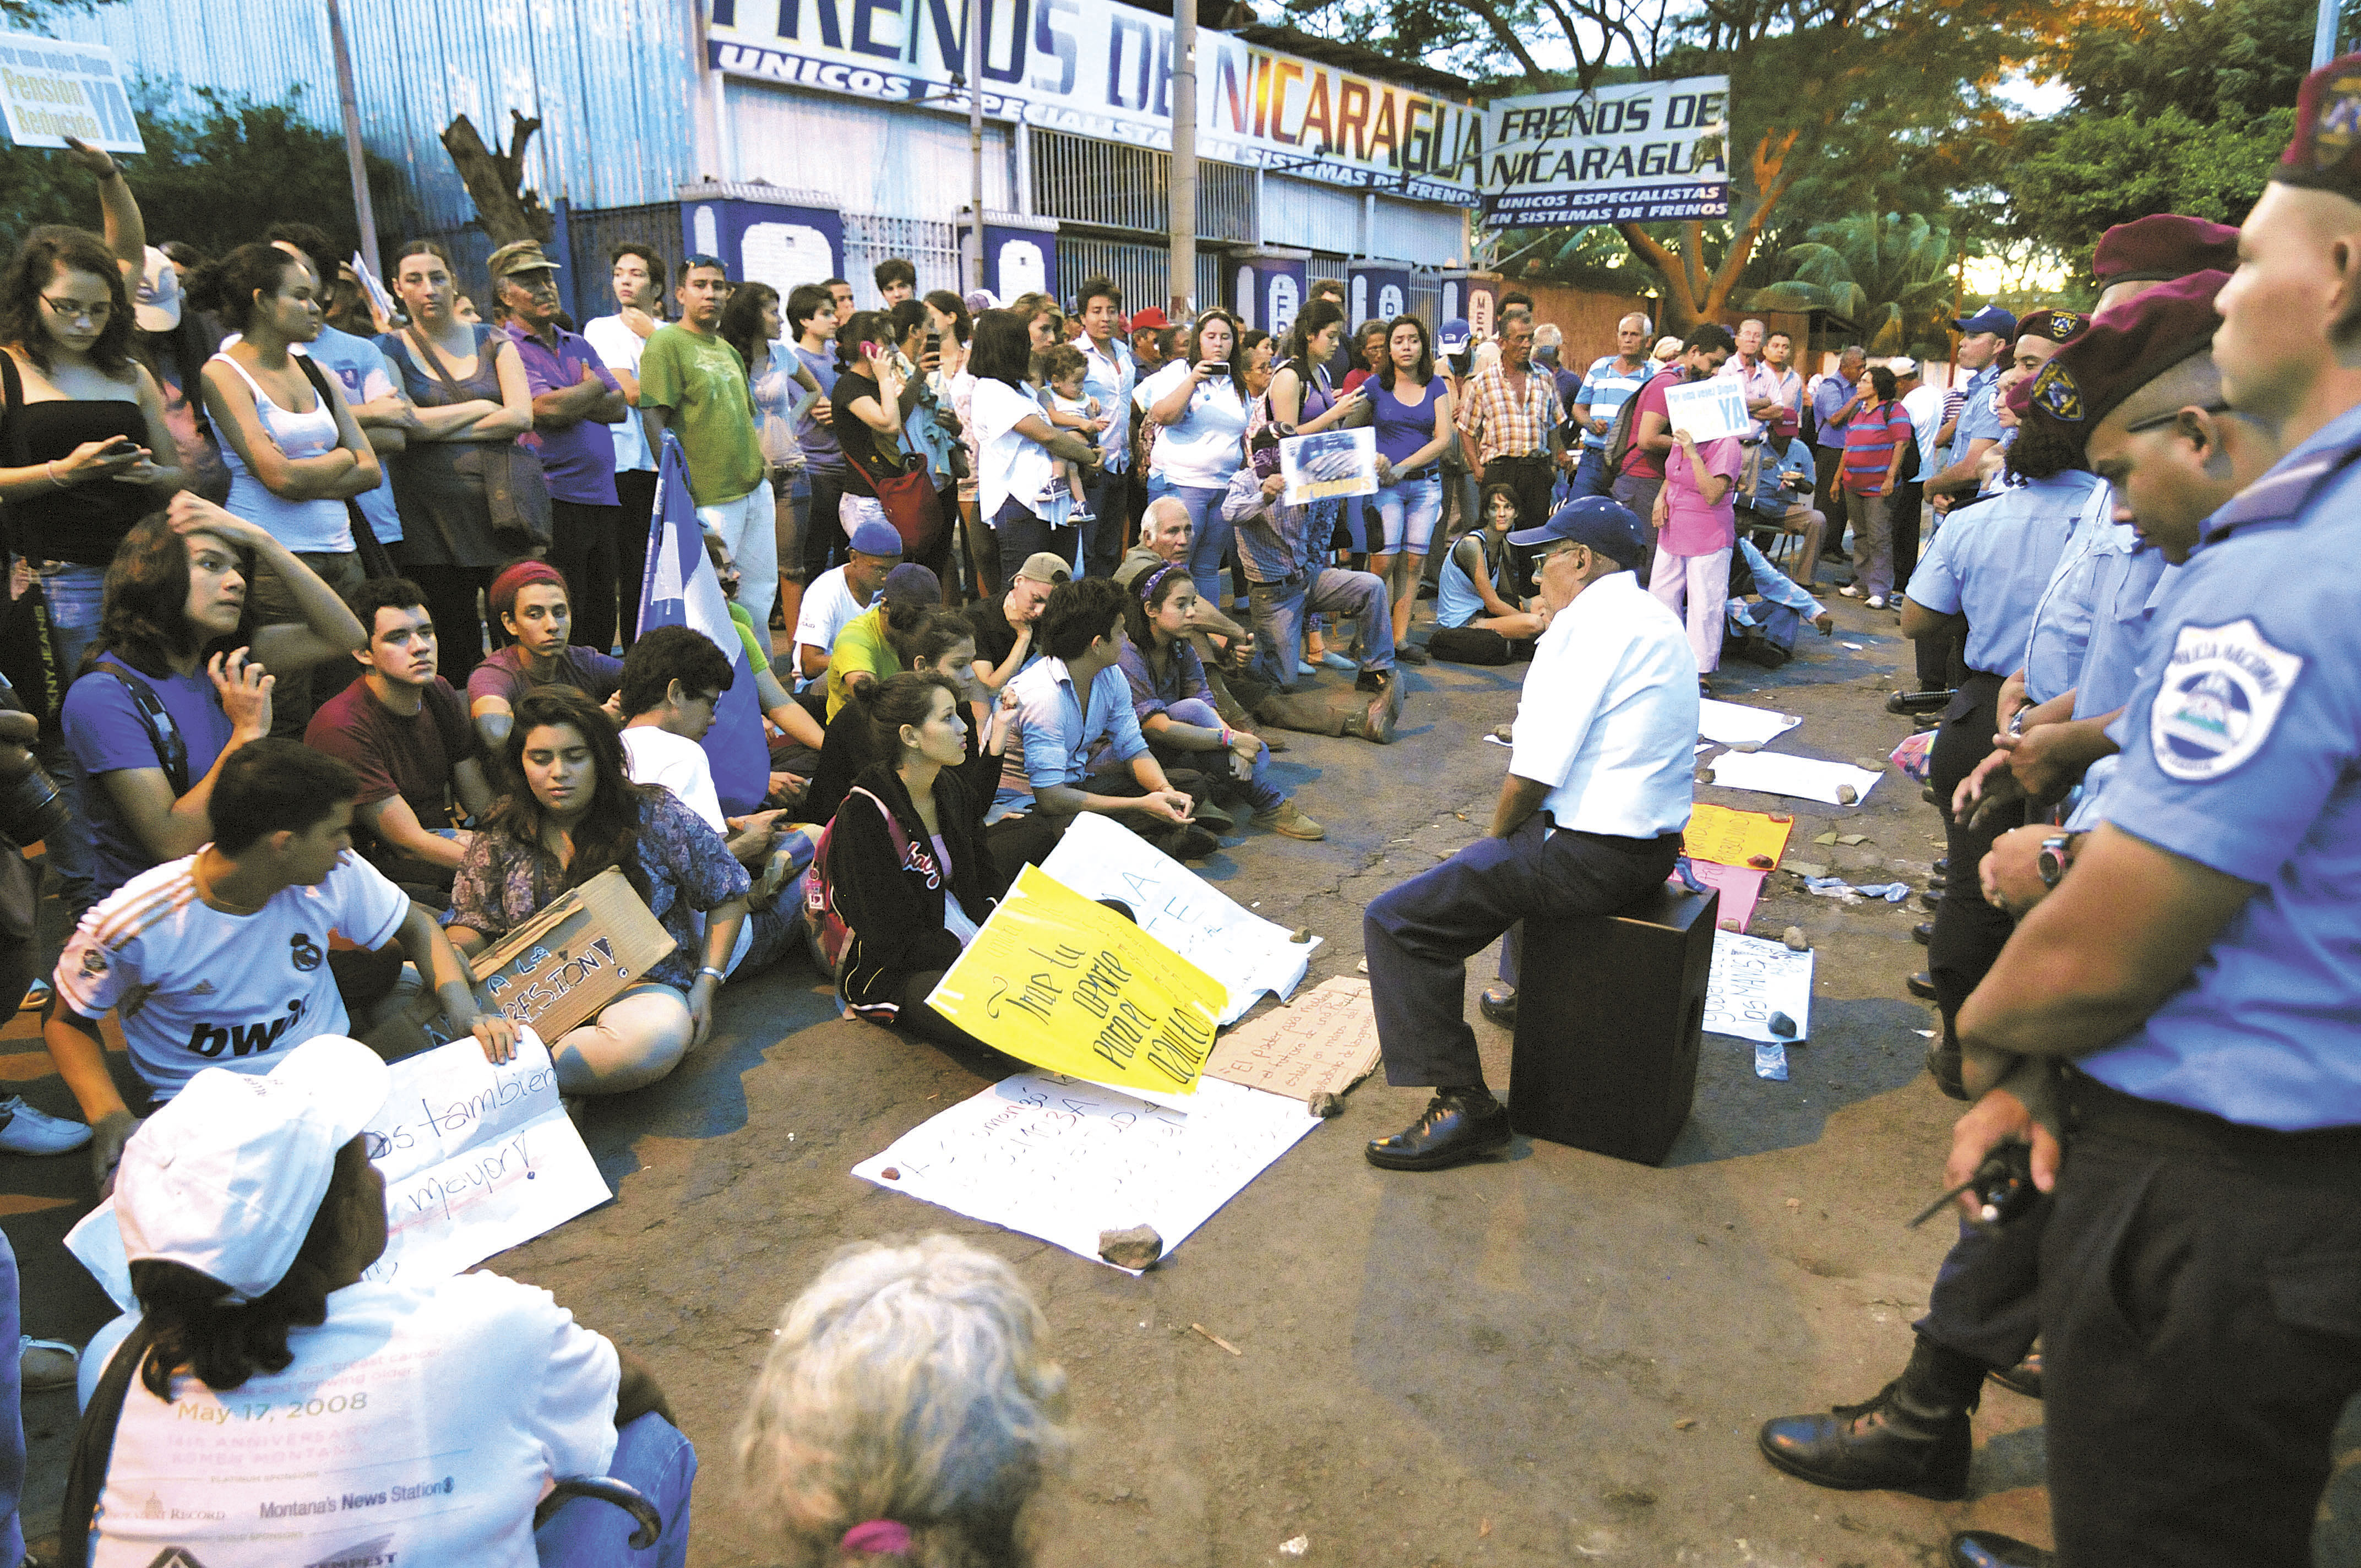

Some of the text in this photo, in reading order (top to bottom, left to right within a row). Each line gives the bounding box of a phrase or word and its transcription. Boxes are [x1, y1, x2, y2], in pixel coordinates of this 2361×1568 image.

[711, 0, 1080, 95] ENOS
[1211, 43, 1483, 188] NICARAGUA
[718, 44, 911, 101] UNICOS
[924, 81, 1173, 147] ESPECIALISTA
[1244, 146, 1368, 188] SISTEMAS
[1497, 92, 1724, 144] FRENOS DE
[1488, 138, 1727, 187] NICARAGUA
[1488, 202, 1728, 225] EN SISTEMAS DE FRENOS
[1497, 186, 1720, 210] UNICOS ESPECIALISTAS
[1718, 396, 1748, 430] YA
[486, 946, 552, 996] A LA
[418, 1067, 557, 1137] tambien
[177, 1401, 231, 1425] May
[243, 1401, 275, 1424] 17,
[286, 1391, 368, 1419] 2008
[171, 1508, 226, 1520] RECORD
[260, 1496, 337, 1520] Montana's
[341, 1487, 387, 1511] News
[391, 1480, 442, 1504] Station
